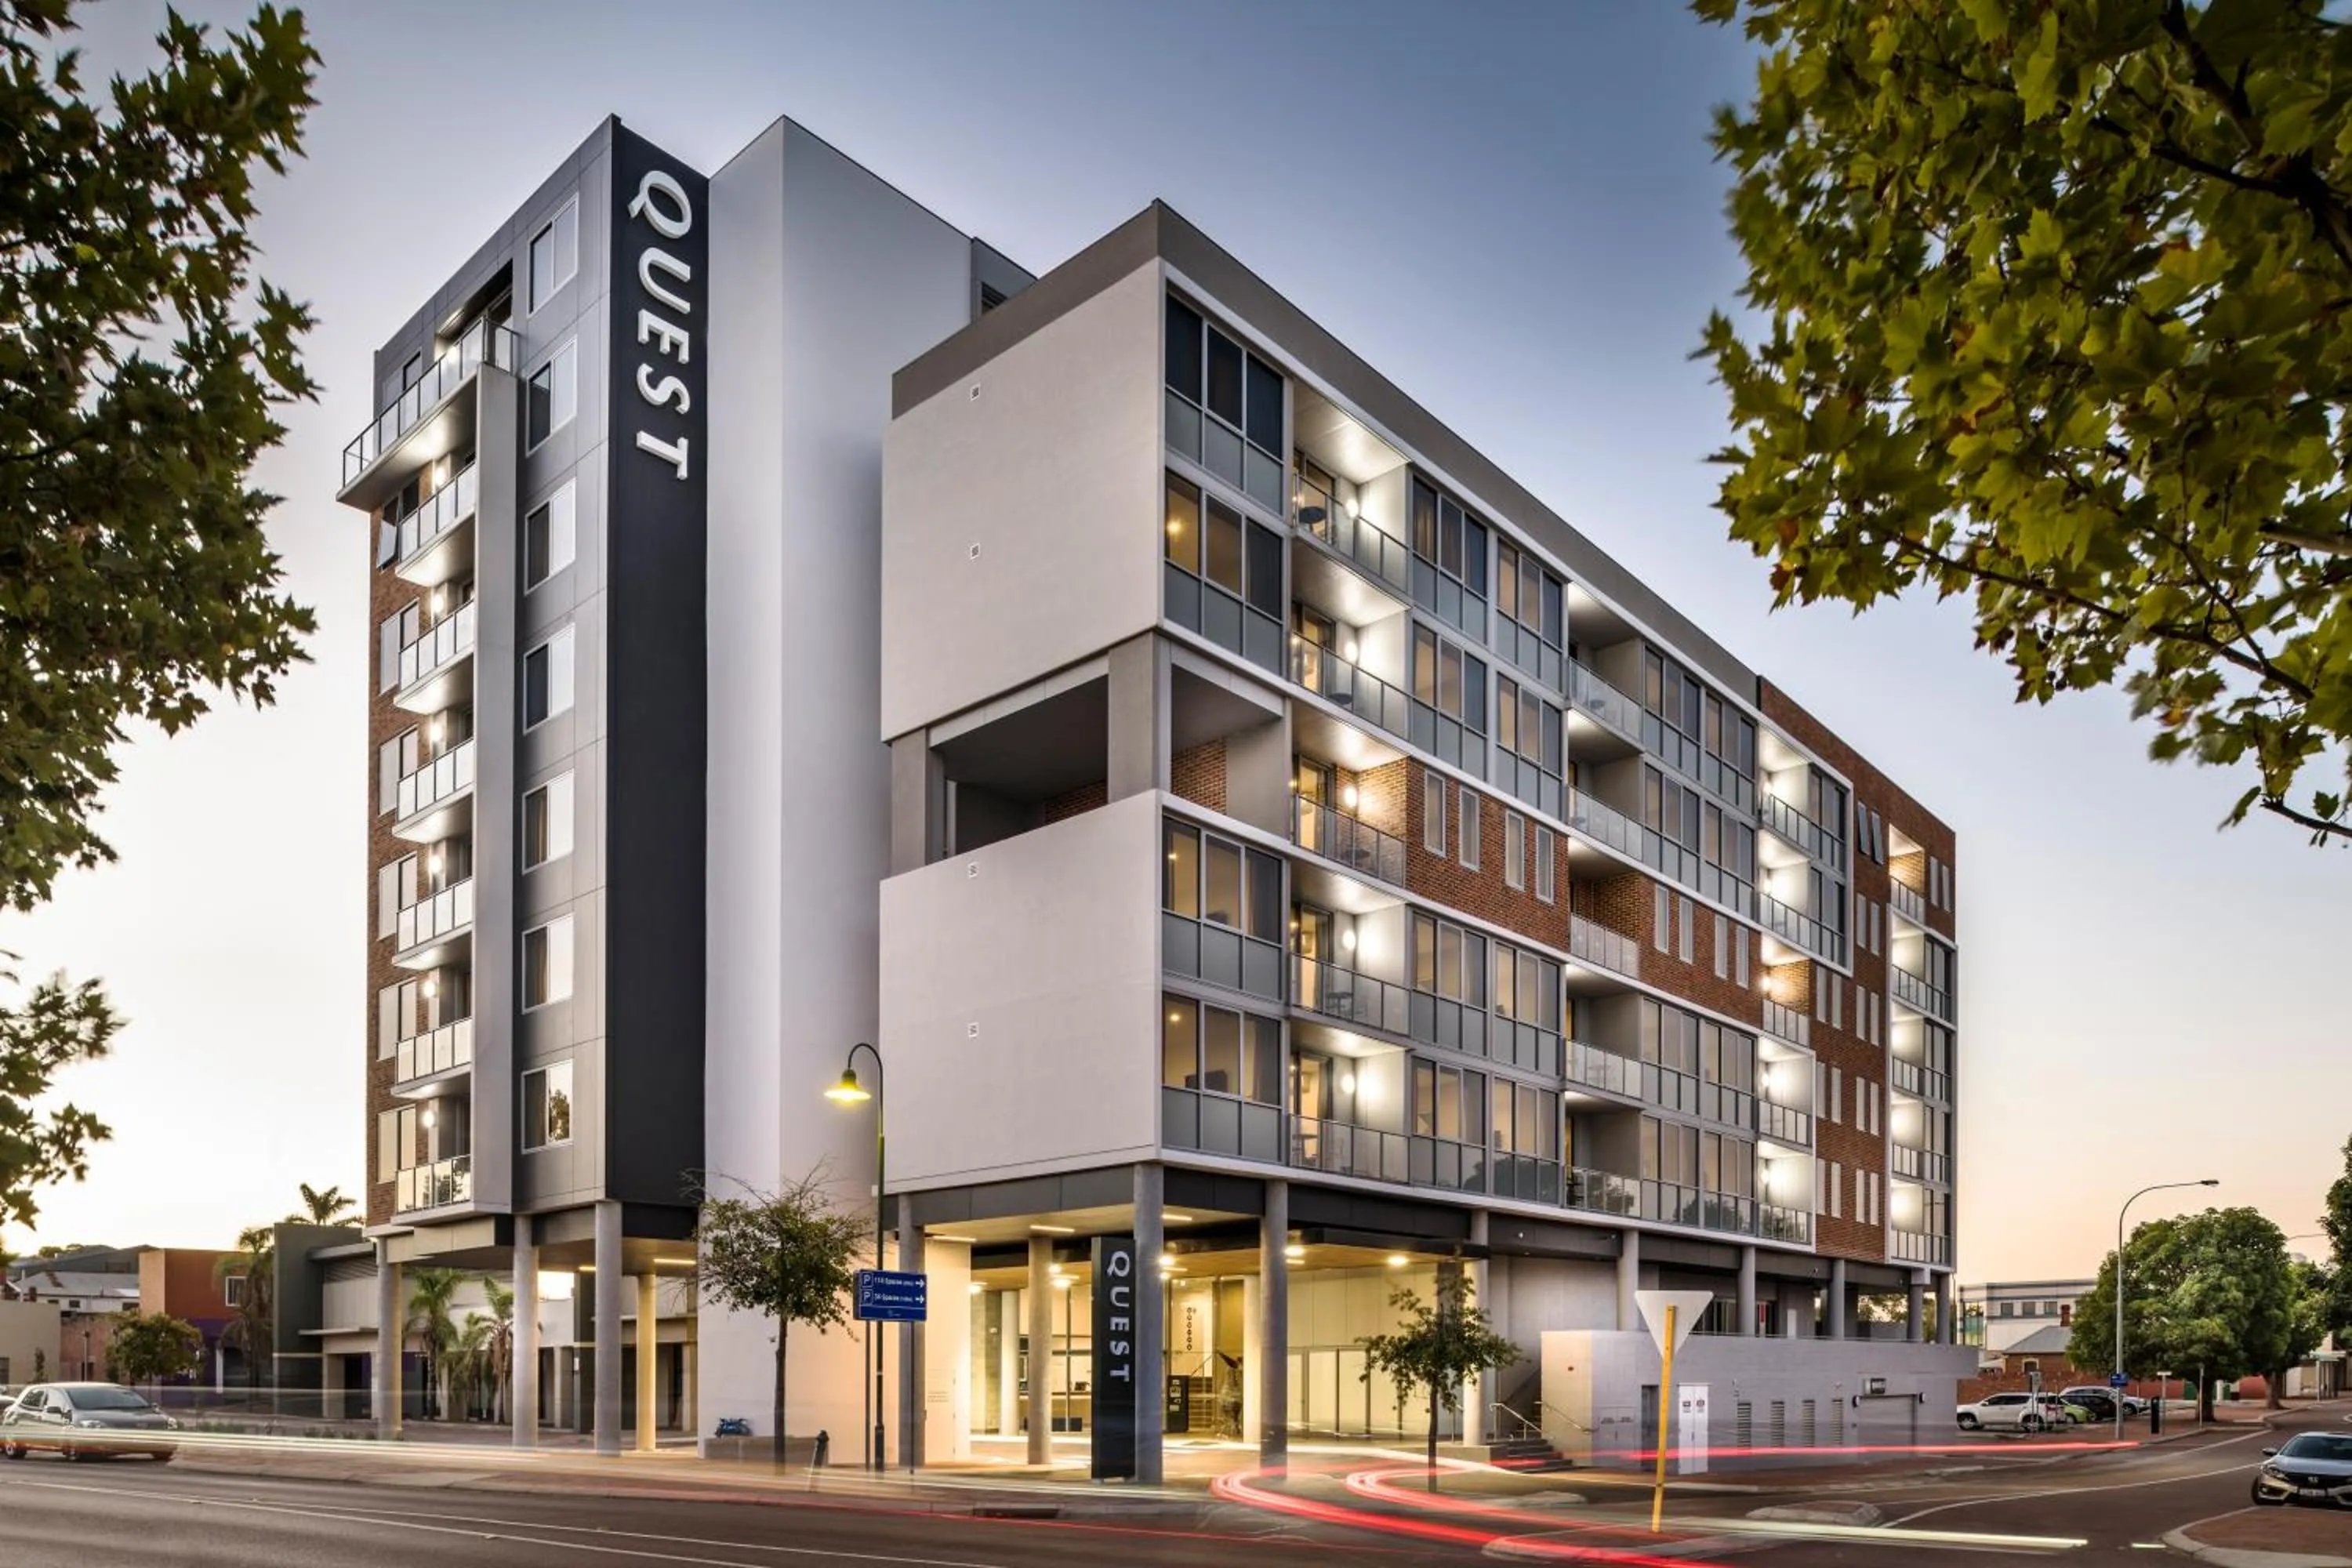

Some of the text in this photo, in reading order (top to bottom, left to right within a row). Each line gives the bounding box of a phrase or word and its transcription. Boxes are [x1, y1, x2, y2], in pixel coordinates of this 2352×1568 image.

[628, 170, 692, 481] QUEST
[864, 1274, 870, 1285] P
[864, 1291, 870, 1301] P
[1107, 1250, 1130, 1382] QUEST
